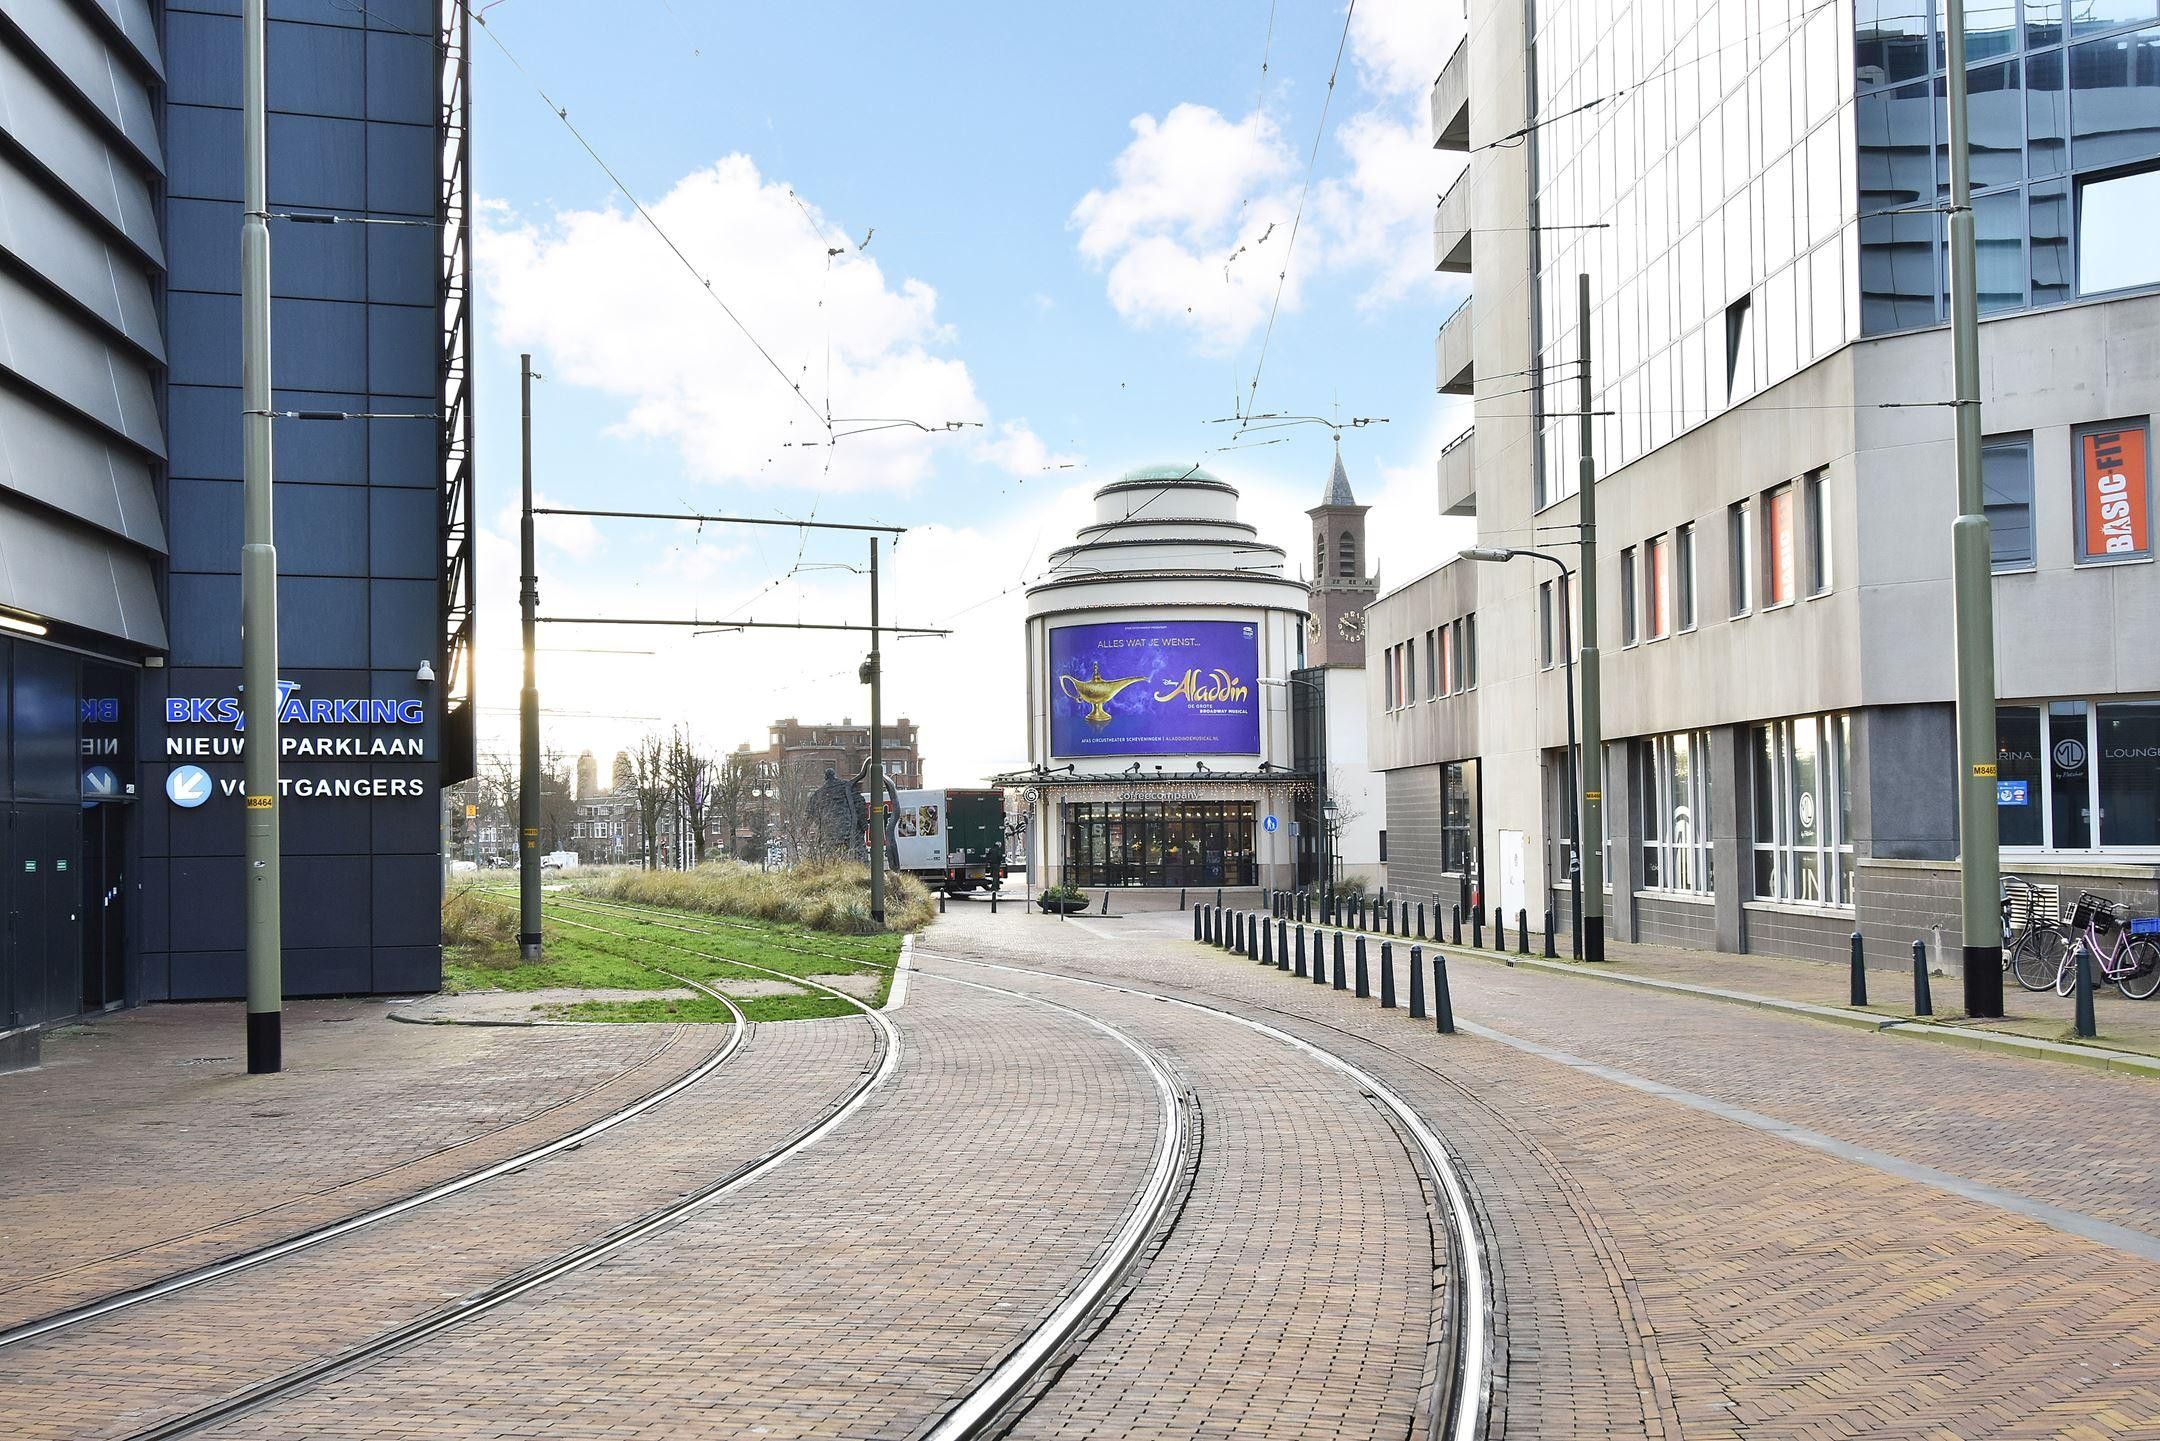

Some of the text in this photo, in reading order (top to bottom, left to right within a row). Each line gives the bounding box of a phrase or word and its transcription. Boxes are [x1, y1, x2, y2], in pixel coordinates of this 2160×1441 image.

[1098, 639, 1124, 648] ALLES
[1126, 639, 1146, 647] WAT
[1149, 638, 1159, 646] JE
[1154, 668, 1248, 702] Aladdin
[166, 698, 239, 723] BKS
[166, 737, 423, 756] NIEU PARKLAAN
[220, 779, 423, 796] VTGANGERS
